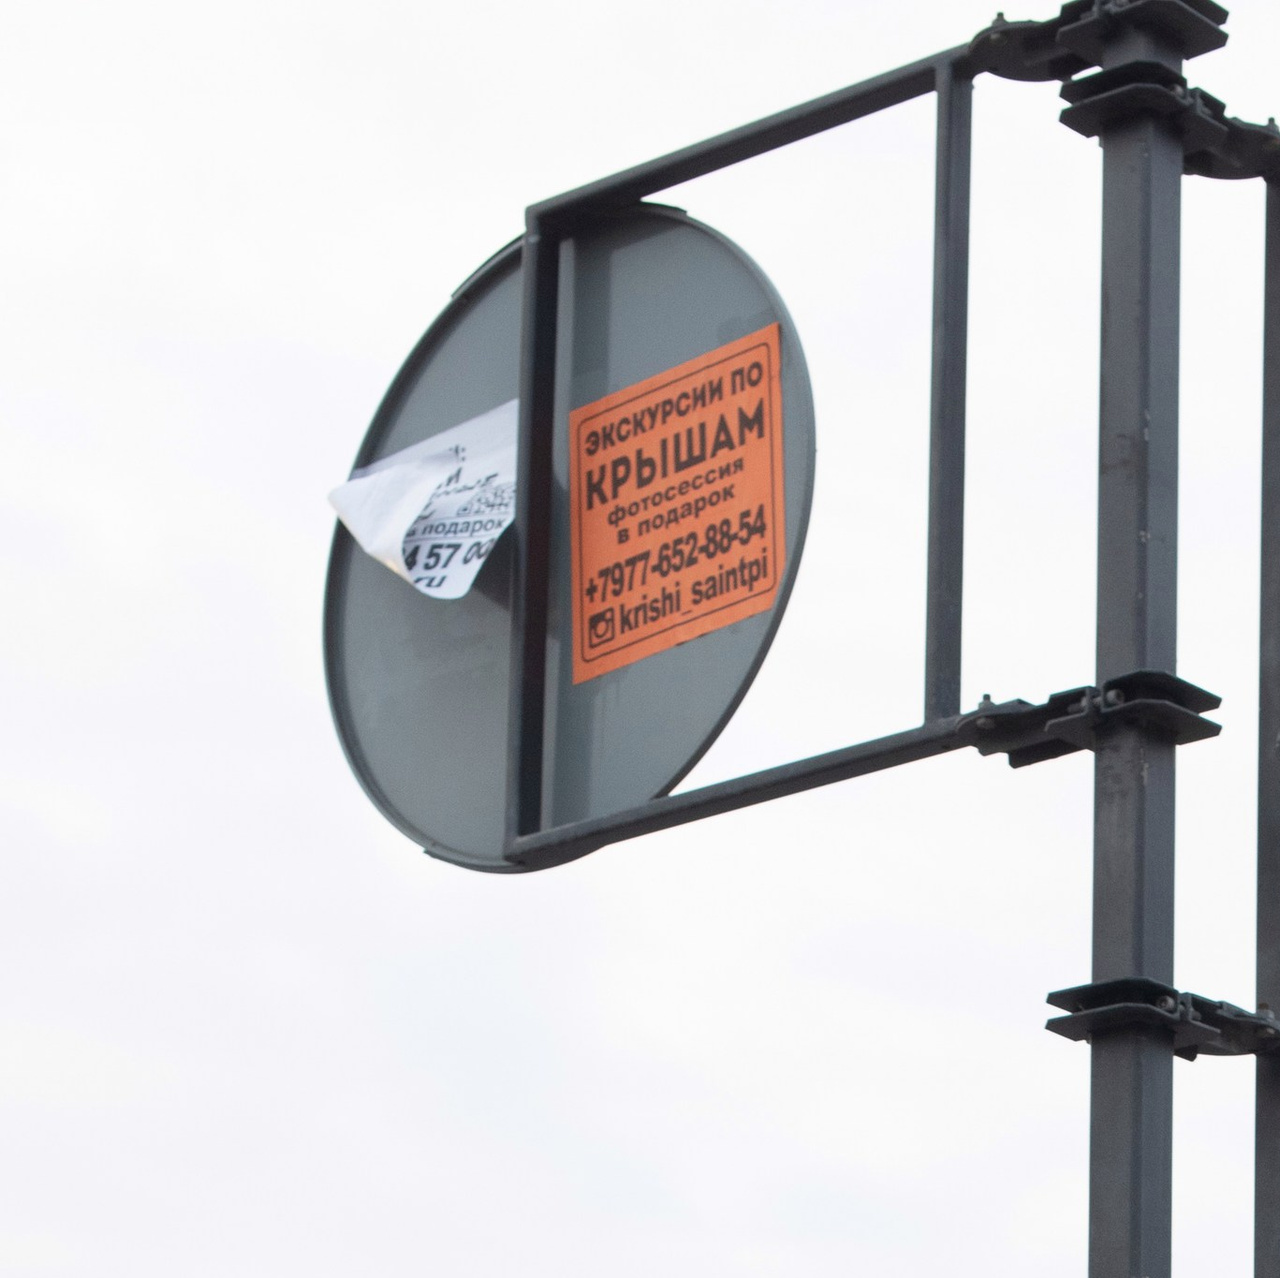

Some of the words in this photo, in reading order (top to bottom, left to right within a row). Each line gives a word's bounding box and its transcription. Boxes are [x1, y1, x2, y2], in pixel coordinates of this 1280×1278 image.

[584, 376, 723, 456] ЭКСКУРСИИ
[730, 361, 763, 395] ПО
[585, 397, 765, 511] КРЫШАМ
[606, 457, 744, 527] фотосессия
[421, 518, 506, 537] подарок
[585, 503, 767, 603] +7977-652-88-54
[617, 527, 630, 544] в
[637, 483, 736, 536] подарок
[423, 542, 462, 570] 57
[619, 546, 768, 635] krishi_saintpi
